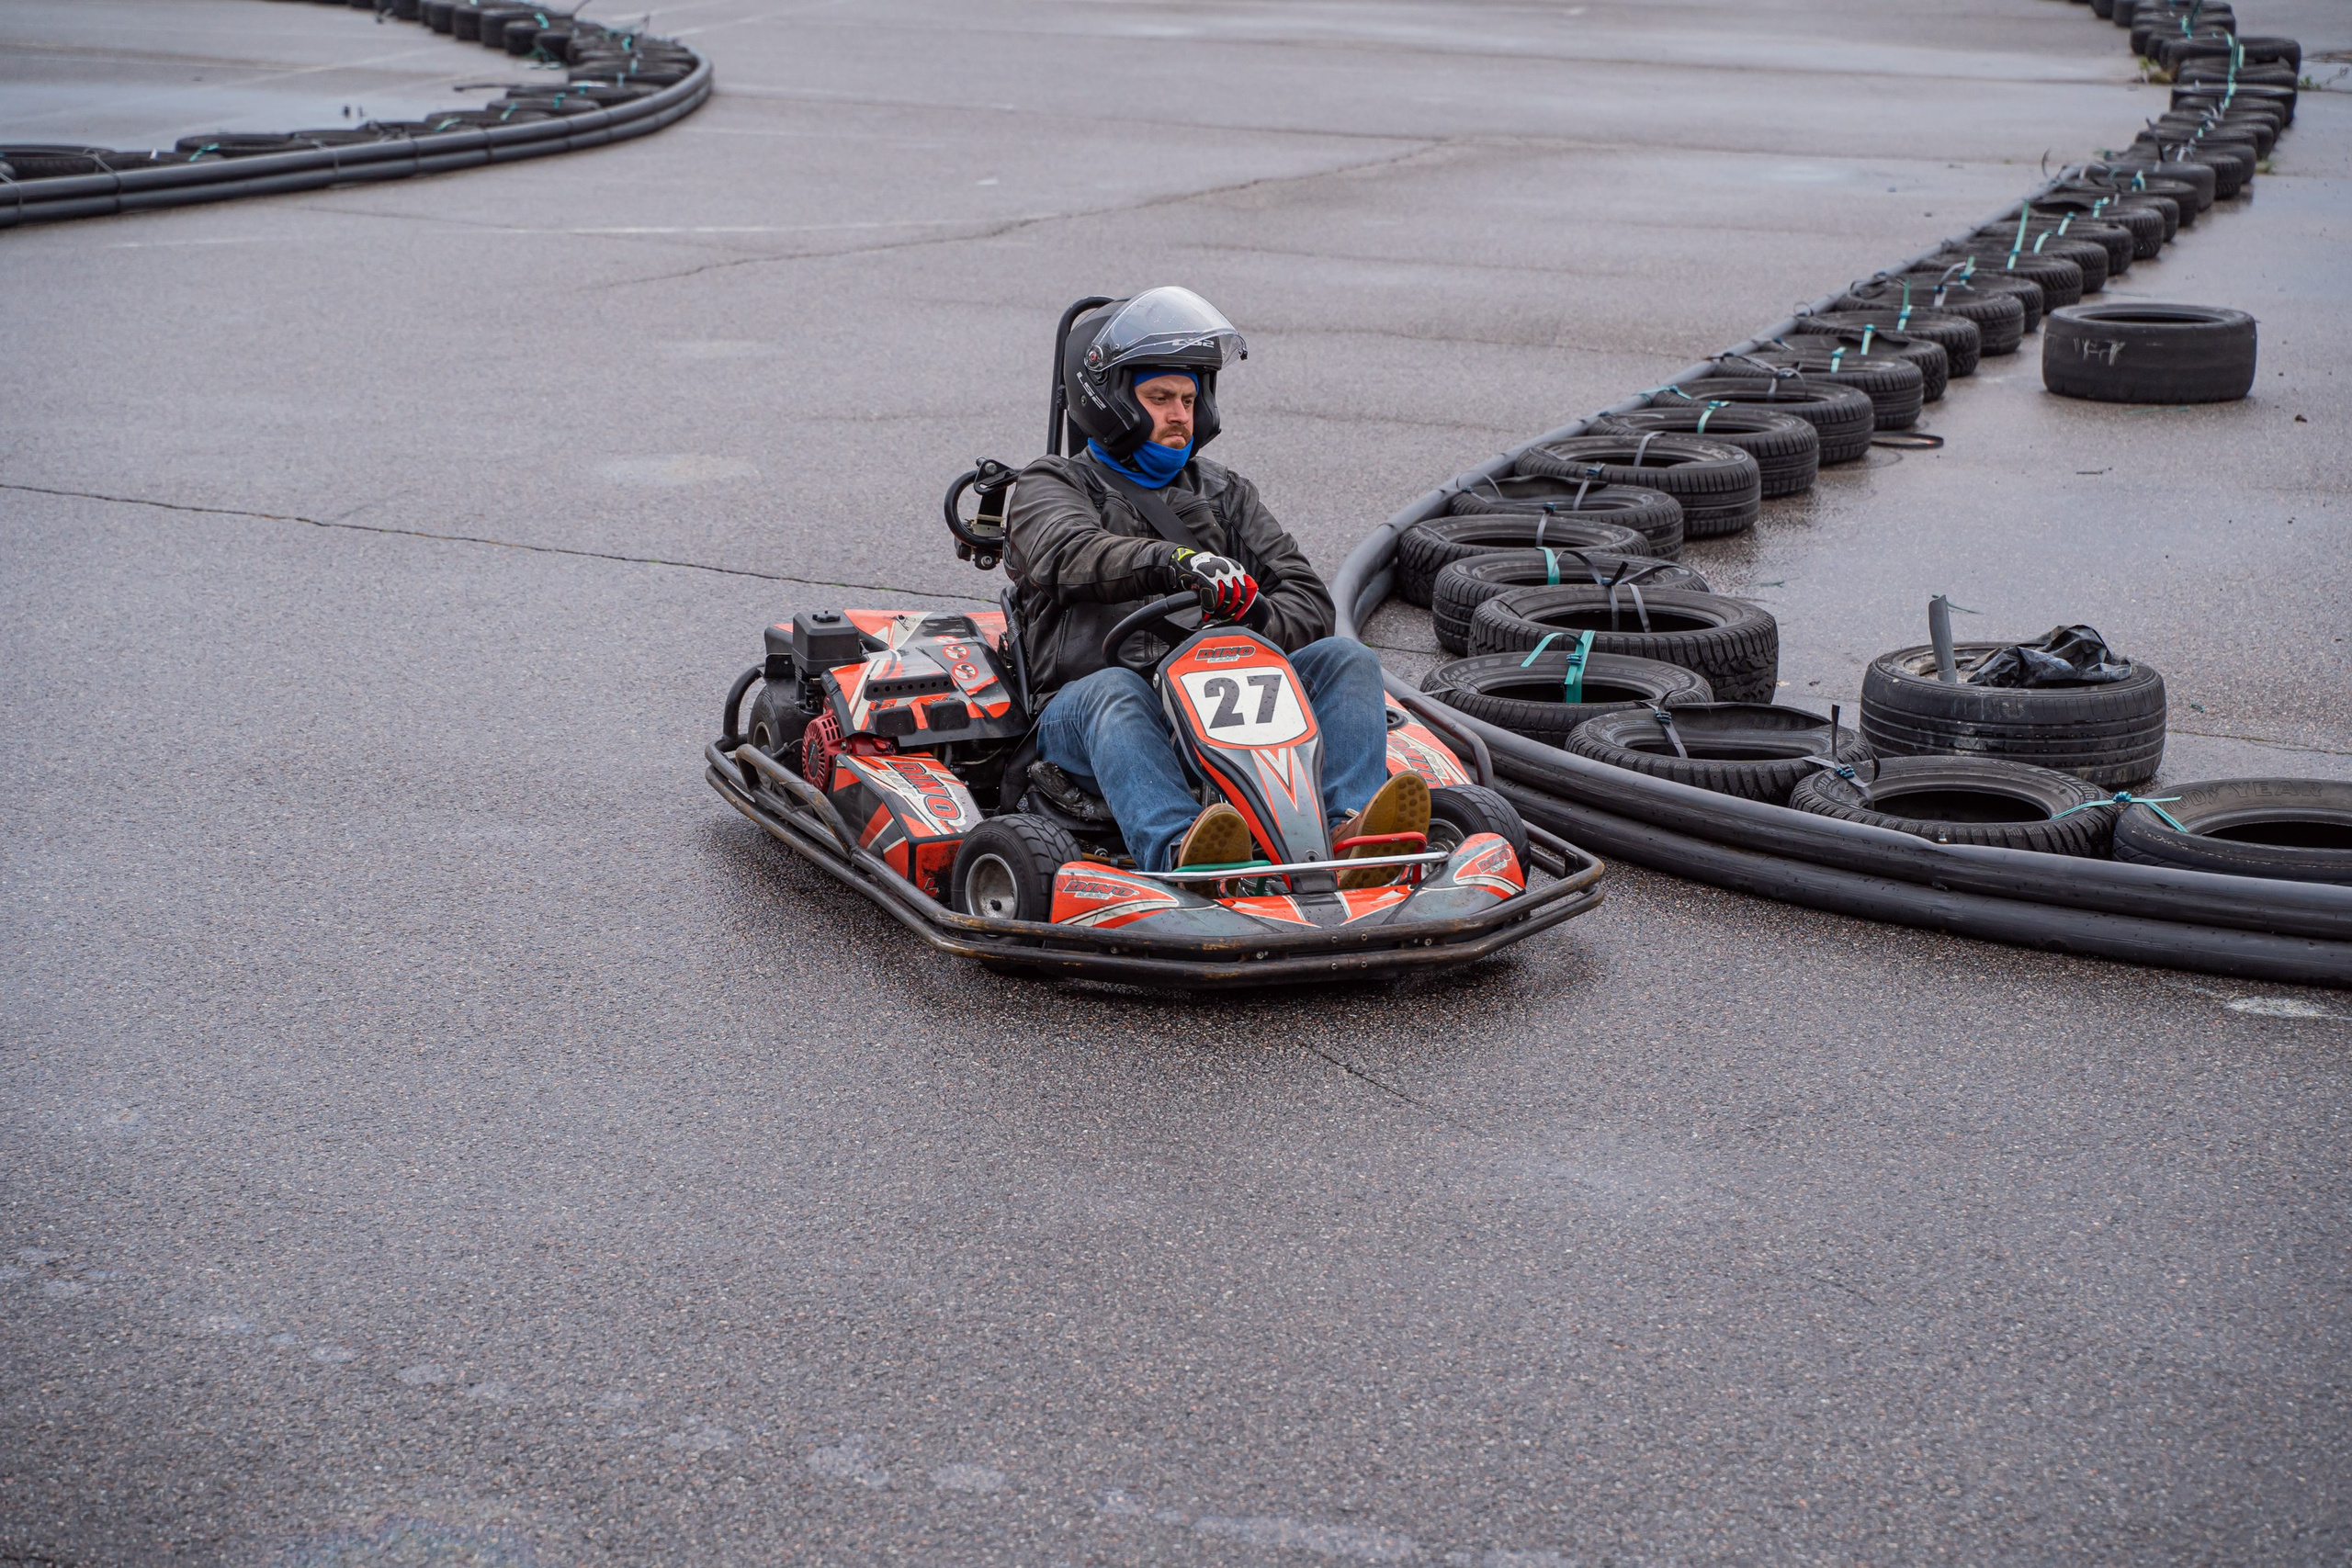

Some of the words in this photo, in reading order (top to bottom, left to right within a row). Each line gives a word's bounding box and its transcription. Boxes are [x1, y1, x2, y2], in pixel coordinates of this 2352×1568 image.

[1076, 371, 1107, 411] LS2
[1196, 646, 1255, 660] DINO
[1204, 674, 1282, 729] 27
[885, 761, 961, 820] DINO
[1063, 880, 1135, 897] DINO
